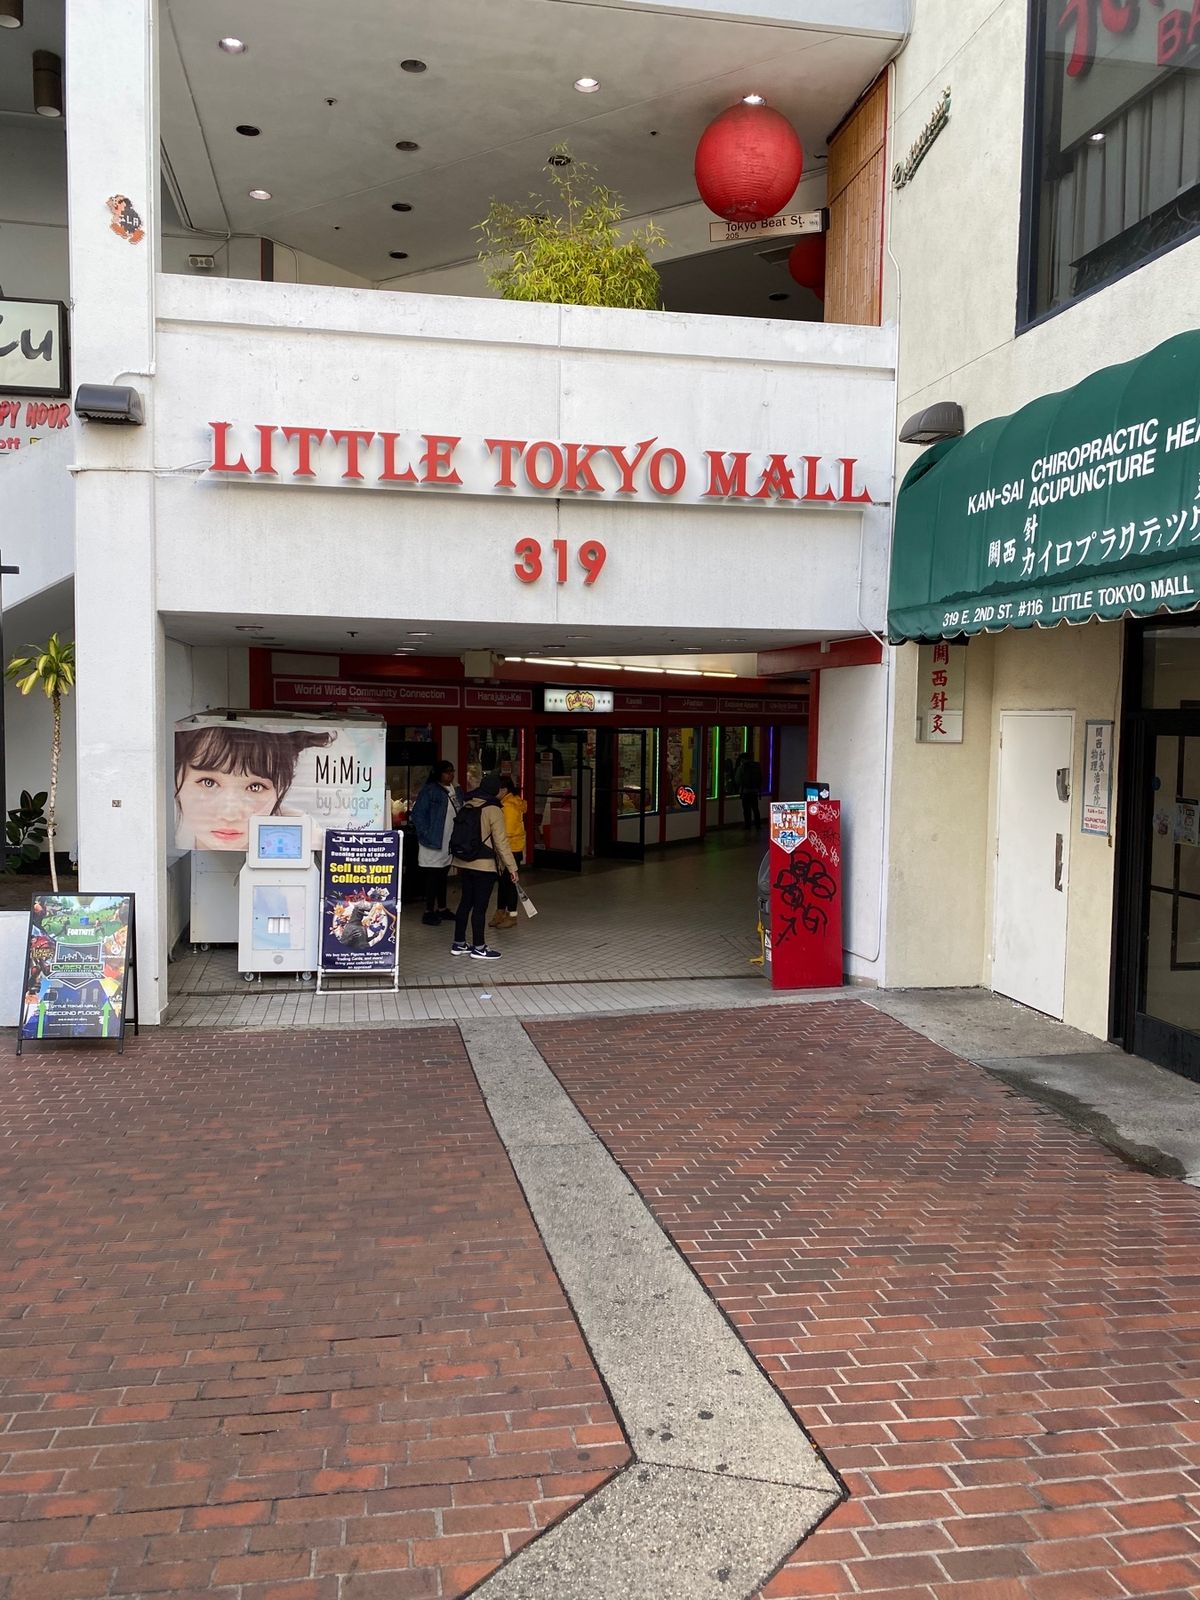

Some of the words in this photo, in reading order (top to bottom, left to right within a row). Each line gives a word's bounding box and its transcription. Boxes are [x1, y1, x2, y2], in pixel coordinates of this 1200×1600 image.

[725, 232, 740, 240] 205
[726, 221, 757, 233] Tokyo
[761, 217, 786, 229] Beat
[26, 403, 71, 429] HOUR
[208, 421, 463, 485] LITTLE
[484, 436, 686, 495] TOKYO
[701, 450, 873, 503] MALL
[1031, 418, 1159, 483] CHIROPRACTIC
[1028, 449, 1157, 509] ACUPUNCTURE
[967, 479, 1025, 516] KAN-SAI
[513, 537, 607, 584] 319
[943, 611, 959, 627] 319
[961, 610, 970, 625] E.
[973, 606, 994, 622] 2ND
[997, 603, 1013, 619] ST.
[1018, 599, 1043, 617] #116
[1051, 591, 1093, 613] LITTLE
[1098, 583, 1145, 606] TOKYO
[1150, 575, 1194, 599] MALL
[294, 683, 322, 695] World
[325, 685, 347, 696] Wide
[349, 686, 398, 698] Community
[399, 688, 445, 699] Connection
[316, 755, 372, 792] MiMiy
[316, 790, 331, 816] by
[335, 790, 373, 816] Sugar
[332, 835, 394, 845] JUNGLE
[330, 863, 352, 873] Sell
[353, 865, 367, 874] us
[369, 865, 395, 875] your
[332, 874, 392, 884] collection!
[67, 928, 95, 937] FORTNITE
